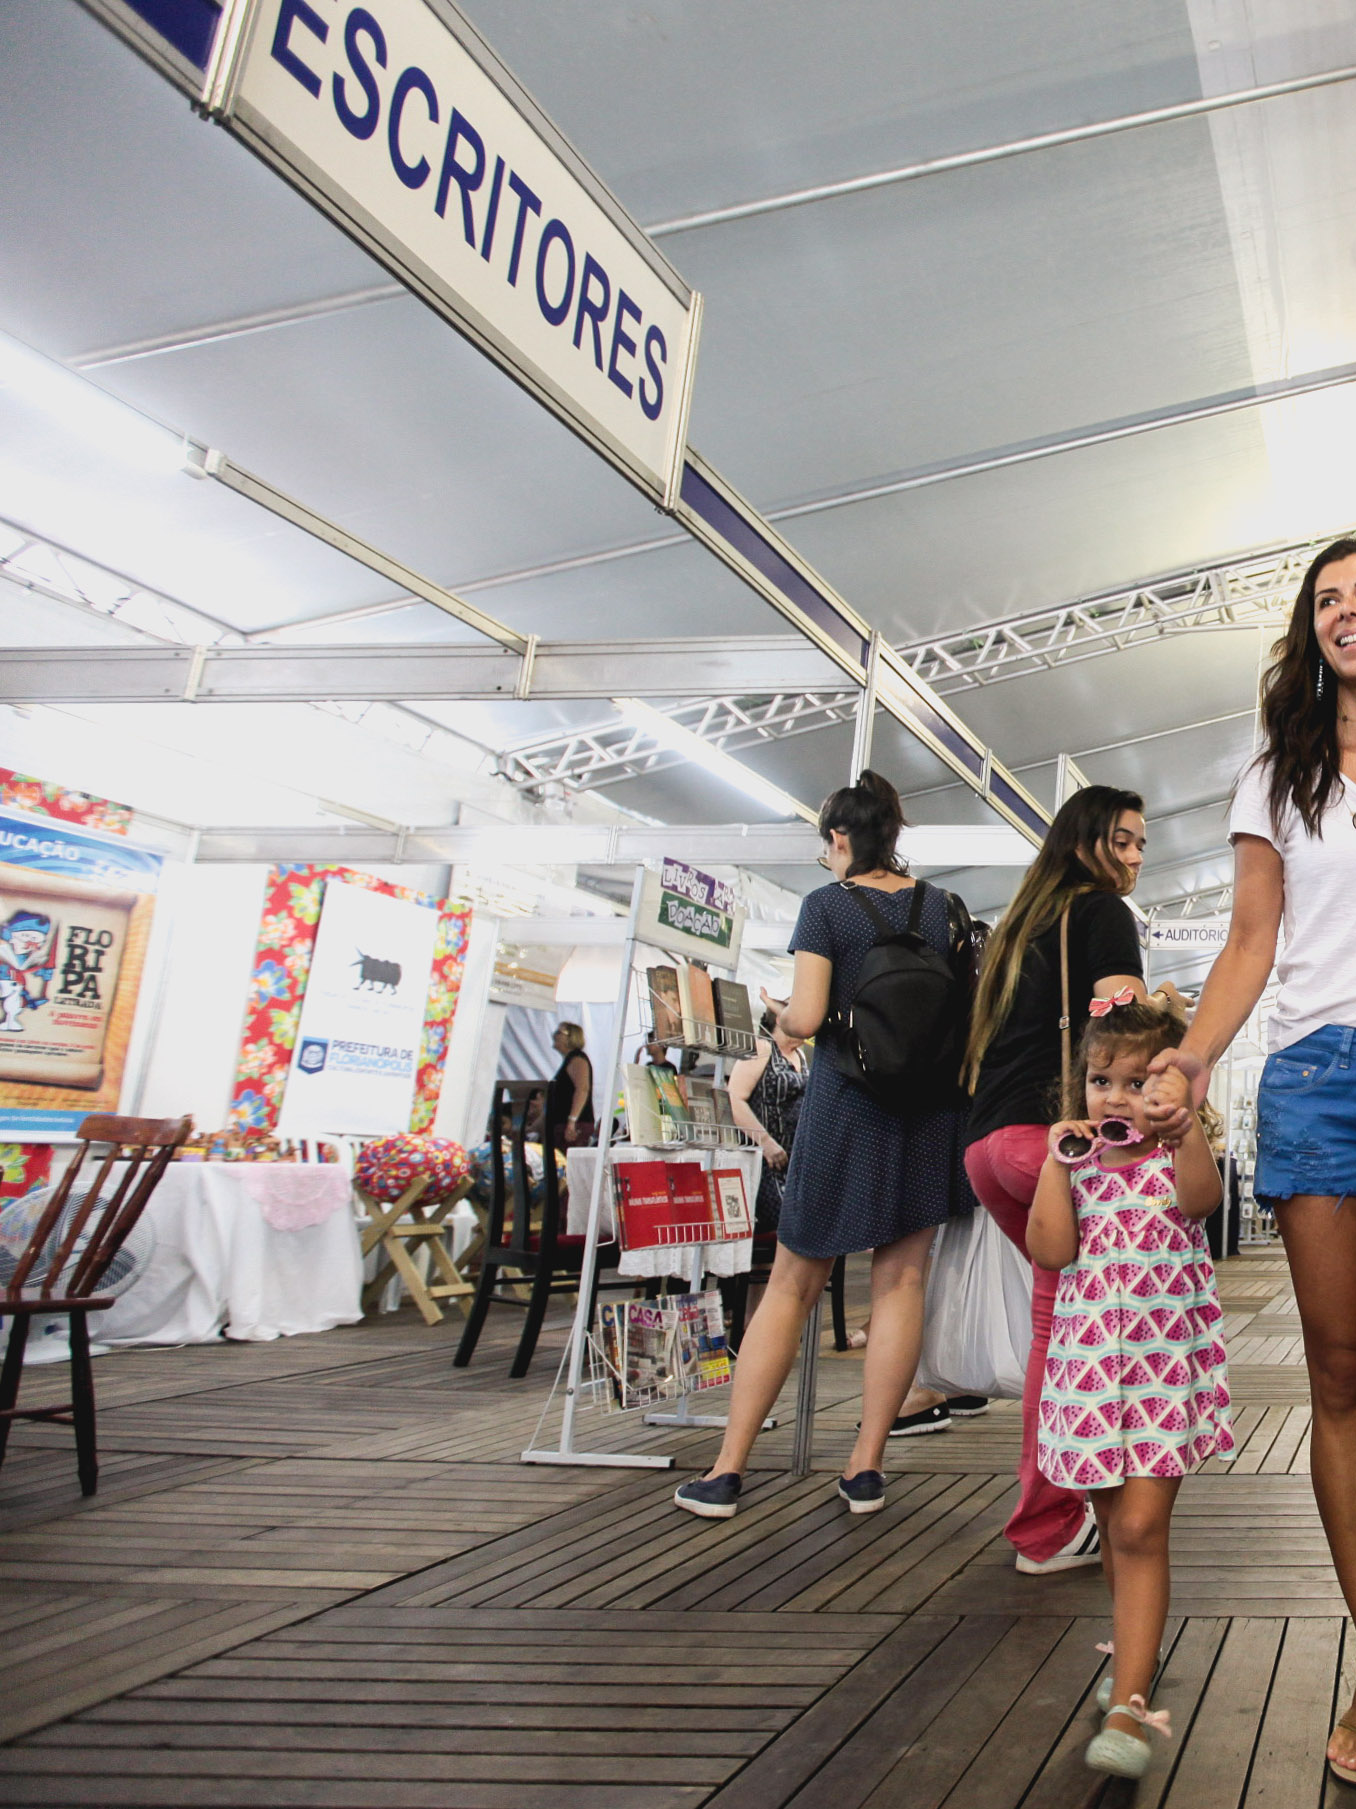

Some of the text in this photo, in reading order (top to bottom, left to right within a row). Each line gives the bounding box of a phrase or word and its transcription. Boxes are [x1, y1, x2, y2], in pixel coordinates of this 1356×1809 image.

[271, 0, 667, 421] ESCRITORES
[664, 867, 706, 900] LIVROS
[67, 926, 113, 949] FLO
[63, 943, 106, 972] RI
[58, 969, 101, 1000] PA
[332, 1039, 414, 1061] PREFEITURA DE
[628, 1304, 664, 1329] CASA
